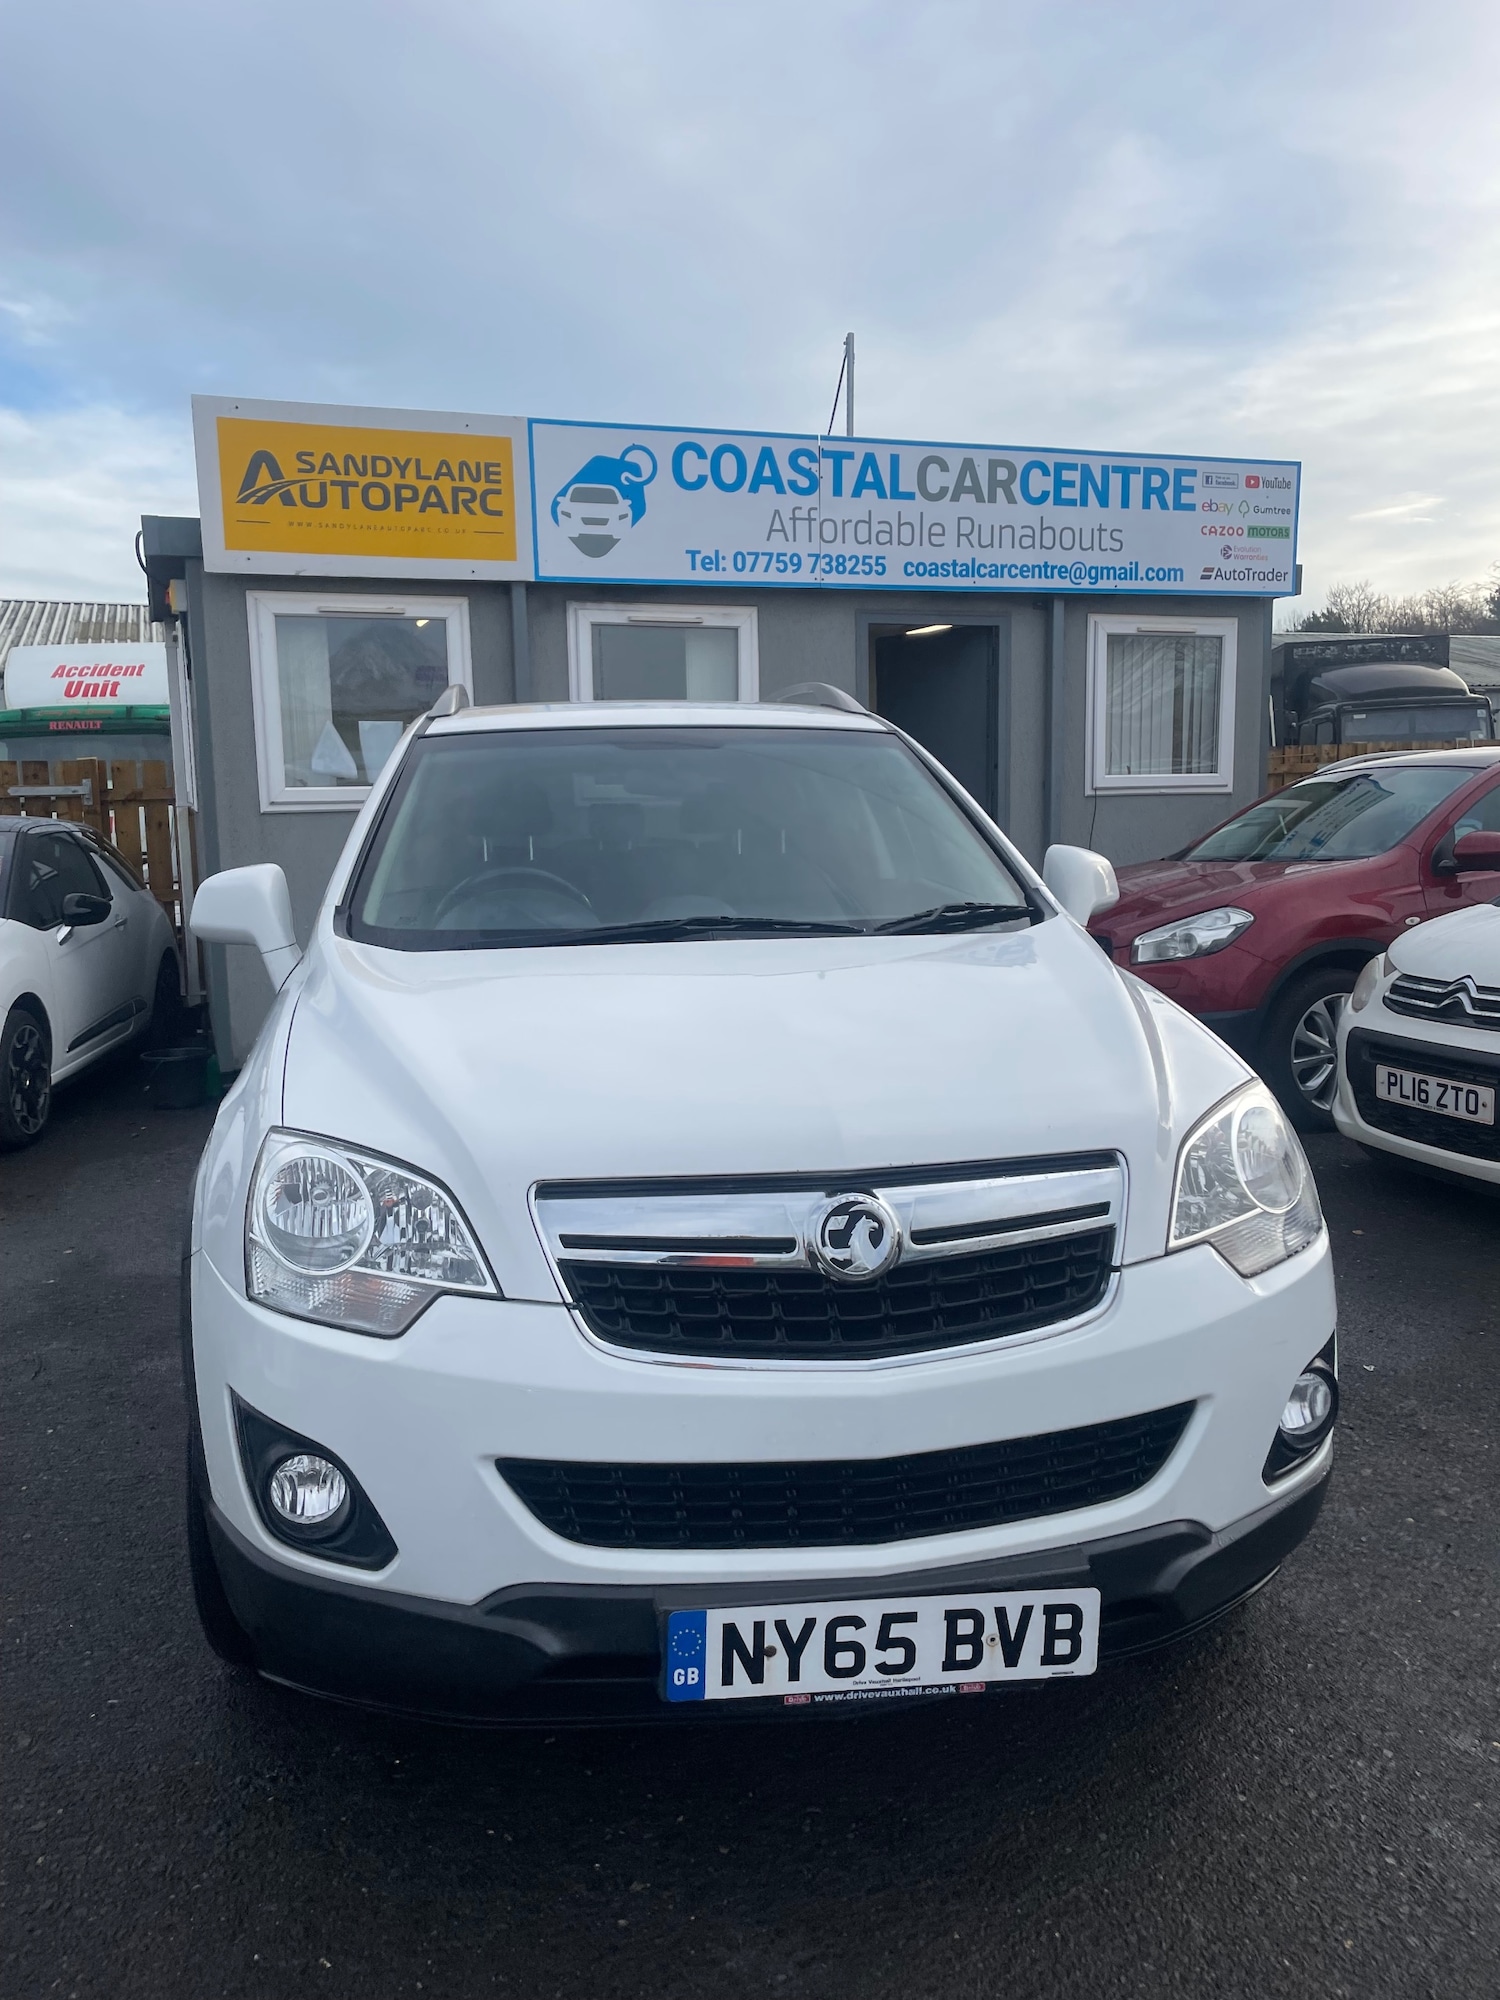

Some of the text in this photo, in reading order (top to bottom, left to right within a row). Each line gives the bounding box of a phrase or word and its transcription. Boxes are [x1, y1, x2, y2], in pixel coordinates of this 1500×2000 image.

[296, 451, 502, 484] SANDYLANE
[236, 450, 504, 517] AUTOPARC
[1261, 476, 1292, 490] YouTube
[1201, 498, 1234, 516] ebay
[1253, 505, 1291, 515] Gumtree
[766, 506, 1124, 553] Affordable Runabouts
[1201, 525, 1244, 536] CAZOO
[685, 549, 1184, 585] Tel: 07759 738255 coastalcarcentre@gmail.com
[1214, 567, 1288, 582] AutoTrader
[51, 664, 145, 678] Accident
[63, 680, 121, 698] Unit
[49, 720, 103, 730] RENAULT
[1387, 1071, 1429, 1104] PL16
[1436, 1082, 1479, 1115] ZTO
[721, 1603, 1083, 1687] NY65 BVB
[673, 1668, 699, 1686] GB
[814, 1684, 956, 1702] www.drivevauxhall.co.uk
